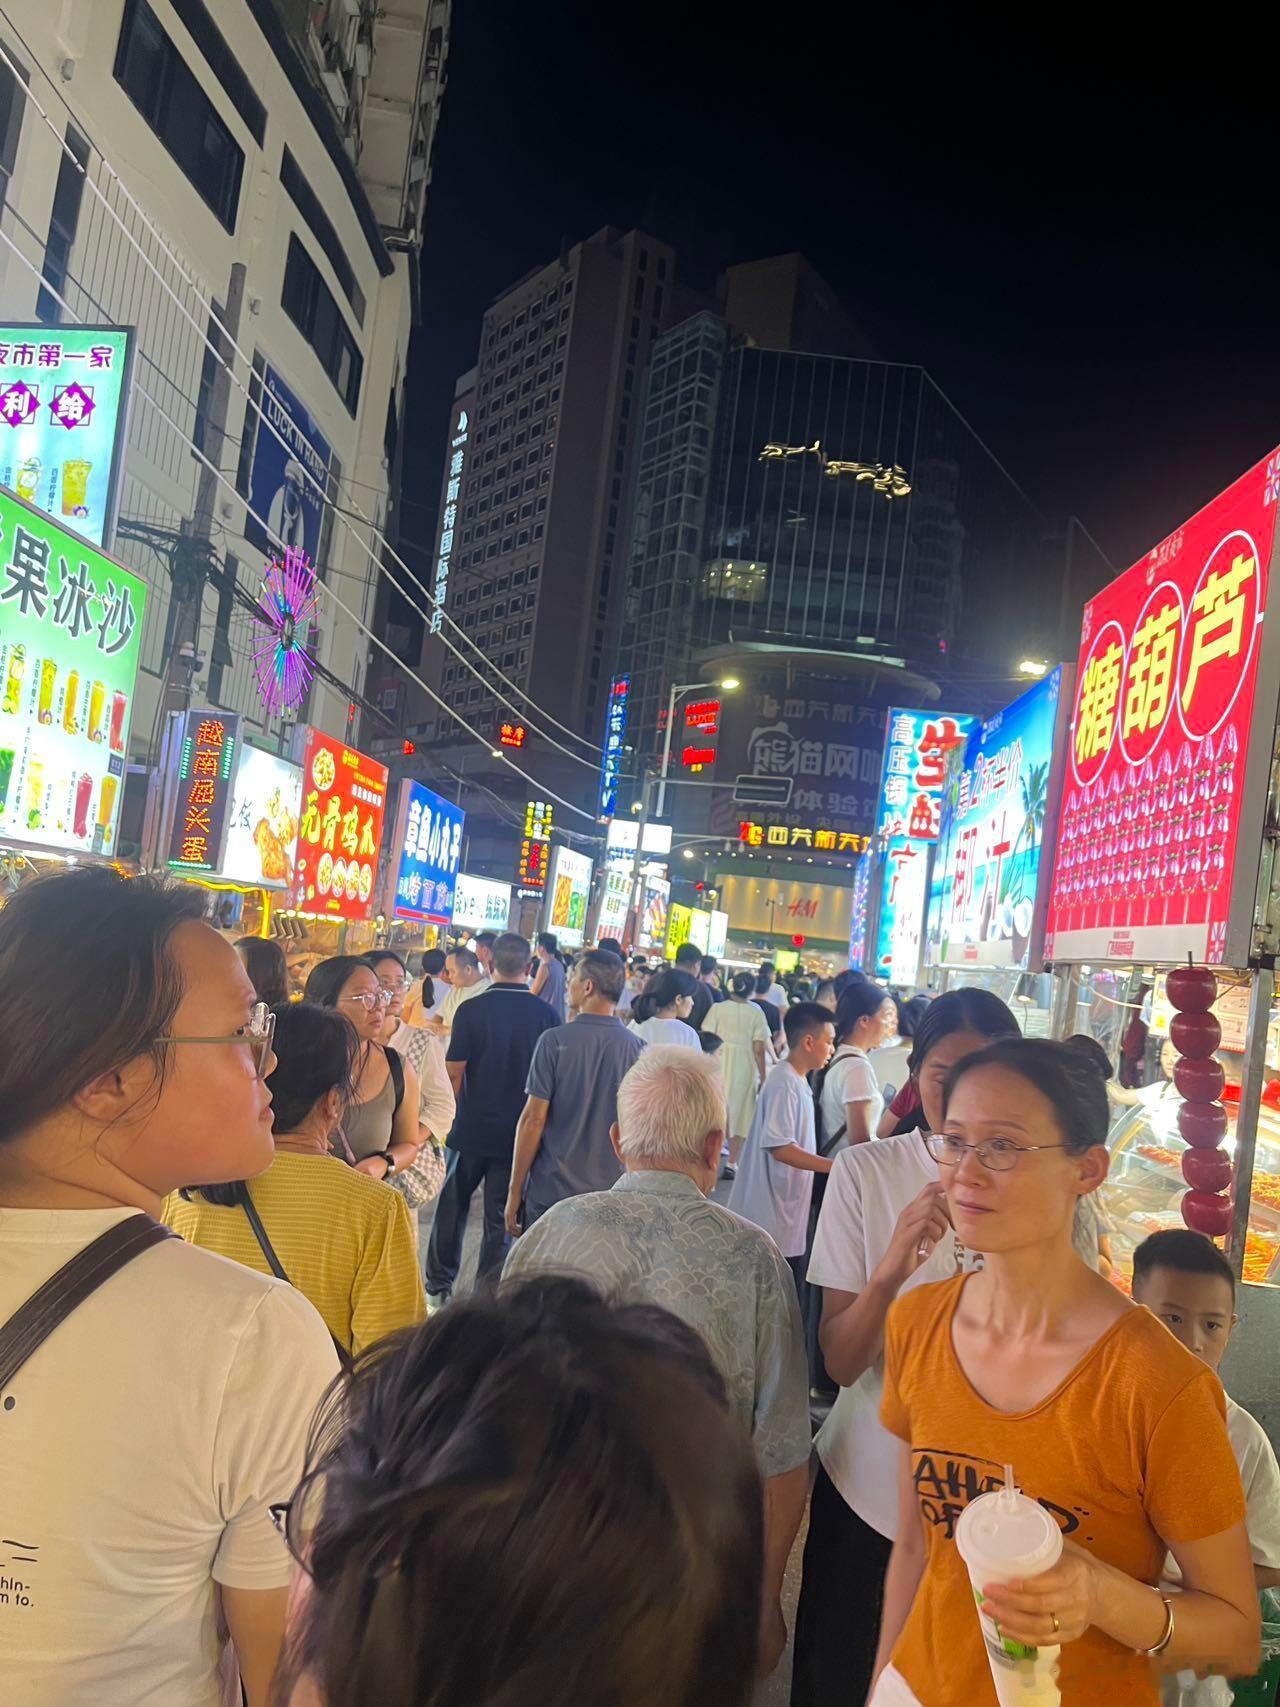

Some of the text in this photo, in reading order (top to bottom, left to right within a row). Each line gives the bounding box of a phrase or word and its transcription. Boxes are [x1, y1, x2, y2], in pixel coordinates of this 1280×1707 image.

[0, 514, 136, 656] 果冰沙
[1075, 553, 1255, 765] 糖葫芦
[784, 699, 881, 728] 西关新天
[15, 1593, 34, 1607] to.
